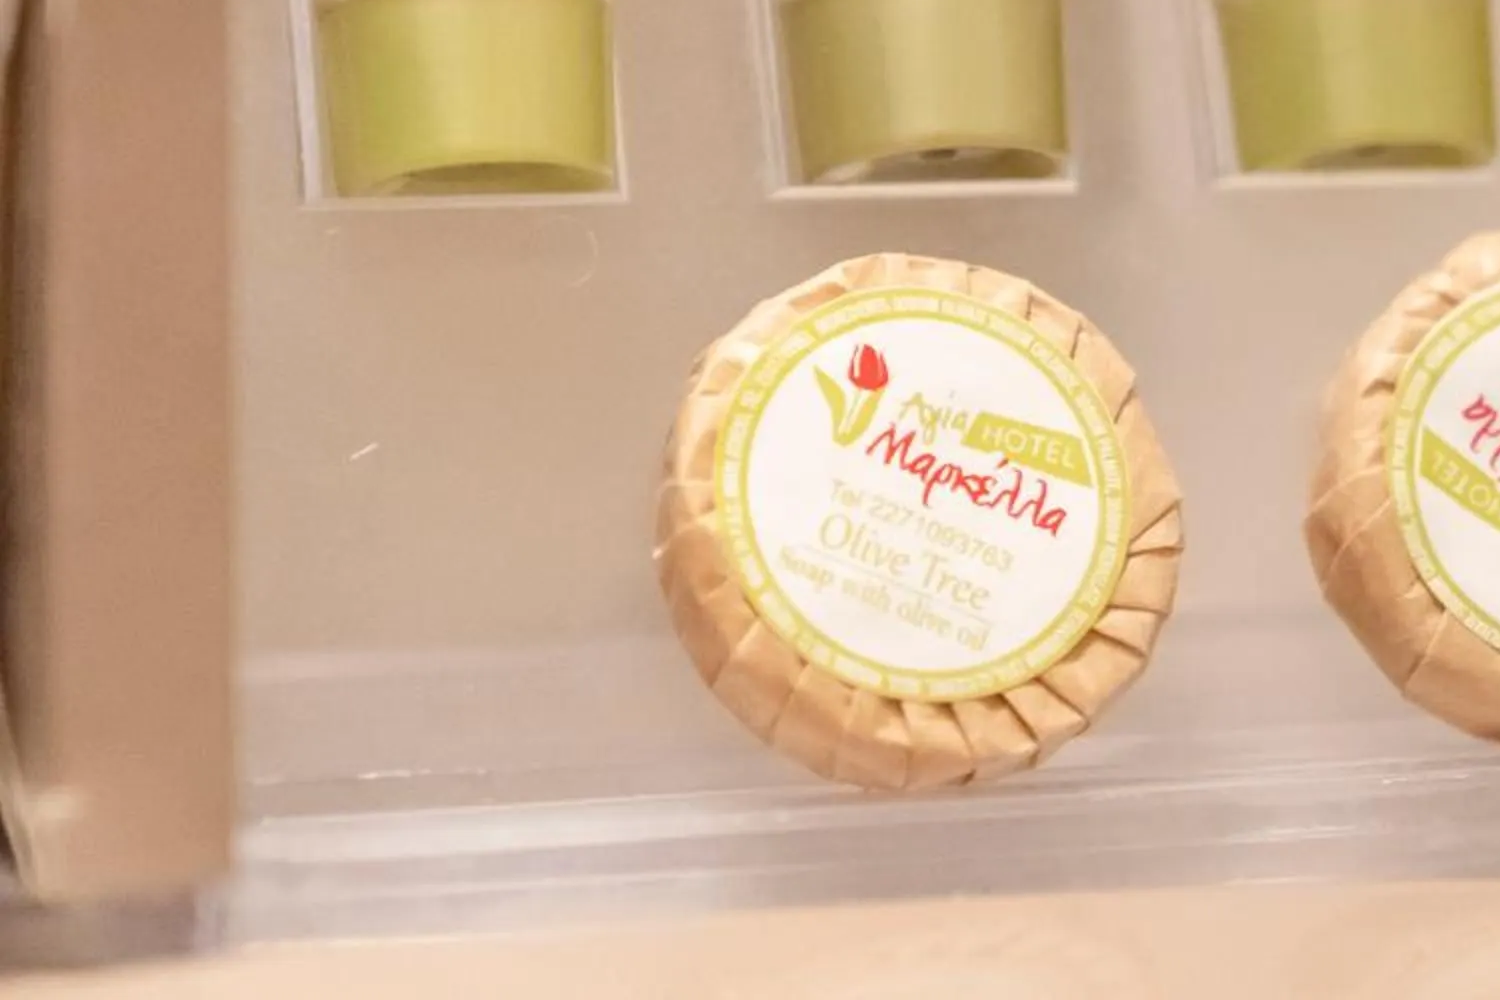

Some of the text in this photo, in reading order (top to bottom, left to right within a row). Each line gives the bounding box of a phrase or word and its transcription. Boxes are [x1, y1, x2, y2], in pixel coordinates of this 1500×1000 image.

[979, 423, 1078, 471] HOTEL
[818, 513, 991, 611] Olive Tree
[895, 595, 952, 638] olive
